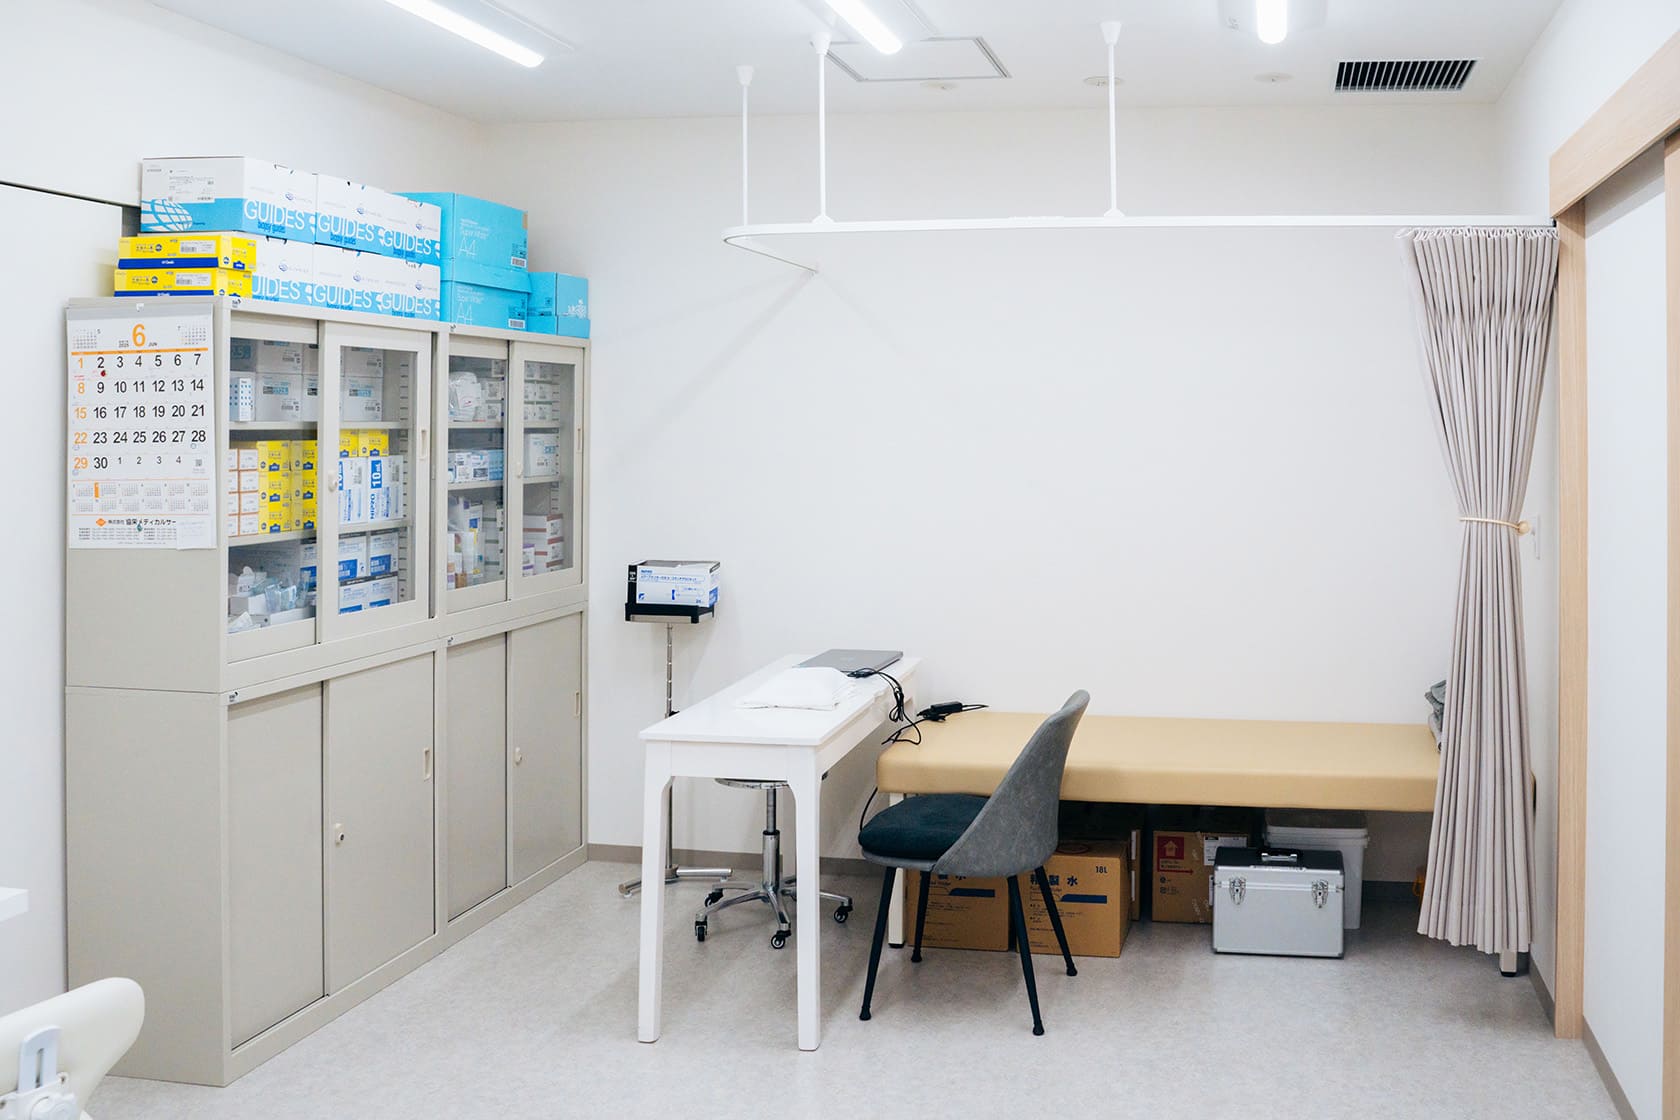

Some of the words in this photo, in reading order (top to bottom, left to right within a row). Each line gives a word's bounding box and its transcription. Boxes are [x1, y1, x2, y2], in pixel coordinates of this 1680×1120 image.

[244, 199, 305, 231] GUIDES
[318, 214, 375, 242] GUIDES
[383, 229, 432, 255] GUIDES
[252, 275, 301, 300] UIDES
[313, 284, 373, 309] GUIDES
[382, 291, 432, 316] GUIDES
[131, 323, 146, 347] 6
[78, 357, 84, 369] 1
[97, 356, 105, 369] 2
[116, 355, 124, 368] 3
[134, 355, 143, 368] 4
[154, 354, 162, 367] 5
[174, 354, 182, 367] 6
[193, 353, 201, 366] 7
[77, 382, 85, 395] 8
[96, 381, 105, 394] 9
[114, 381, 127, 394] 10
[133, 381, 145, 393] 11
[152, 380, 166, 393] 12
[171, 379, 185, 392] 13
[190, 379, 205, 392] 14
[74, 408, 87, 419] 15
[93, 406, 107, 419] 16
[114, 406, 127, 419] 17
[133, 406, 146, 418] 18
[152, 405, 166, 418] 19
[171, 405, 186, 417] 20
[191, 404, 205, 417] 21
[74, 432, 88, 444] 22
[93, 431, 108, 444] 23
[113, 431, 128, 444] 24
[133, 431, 147, 444] 25
[152, 431, 167, 443] 26
[171, 430, 186, 443] 27
[191, 430, 207, 443] 28
[73, 457, 88, 469] 29
[93, 456, 108, 469] 30
[136, 456, 142, 464] 2
[156, 456, 162, 464] 3
[176, 455, 182, 464] 4
[1095, 865, 1108, 874] 18L
